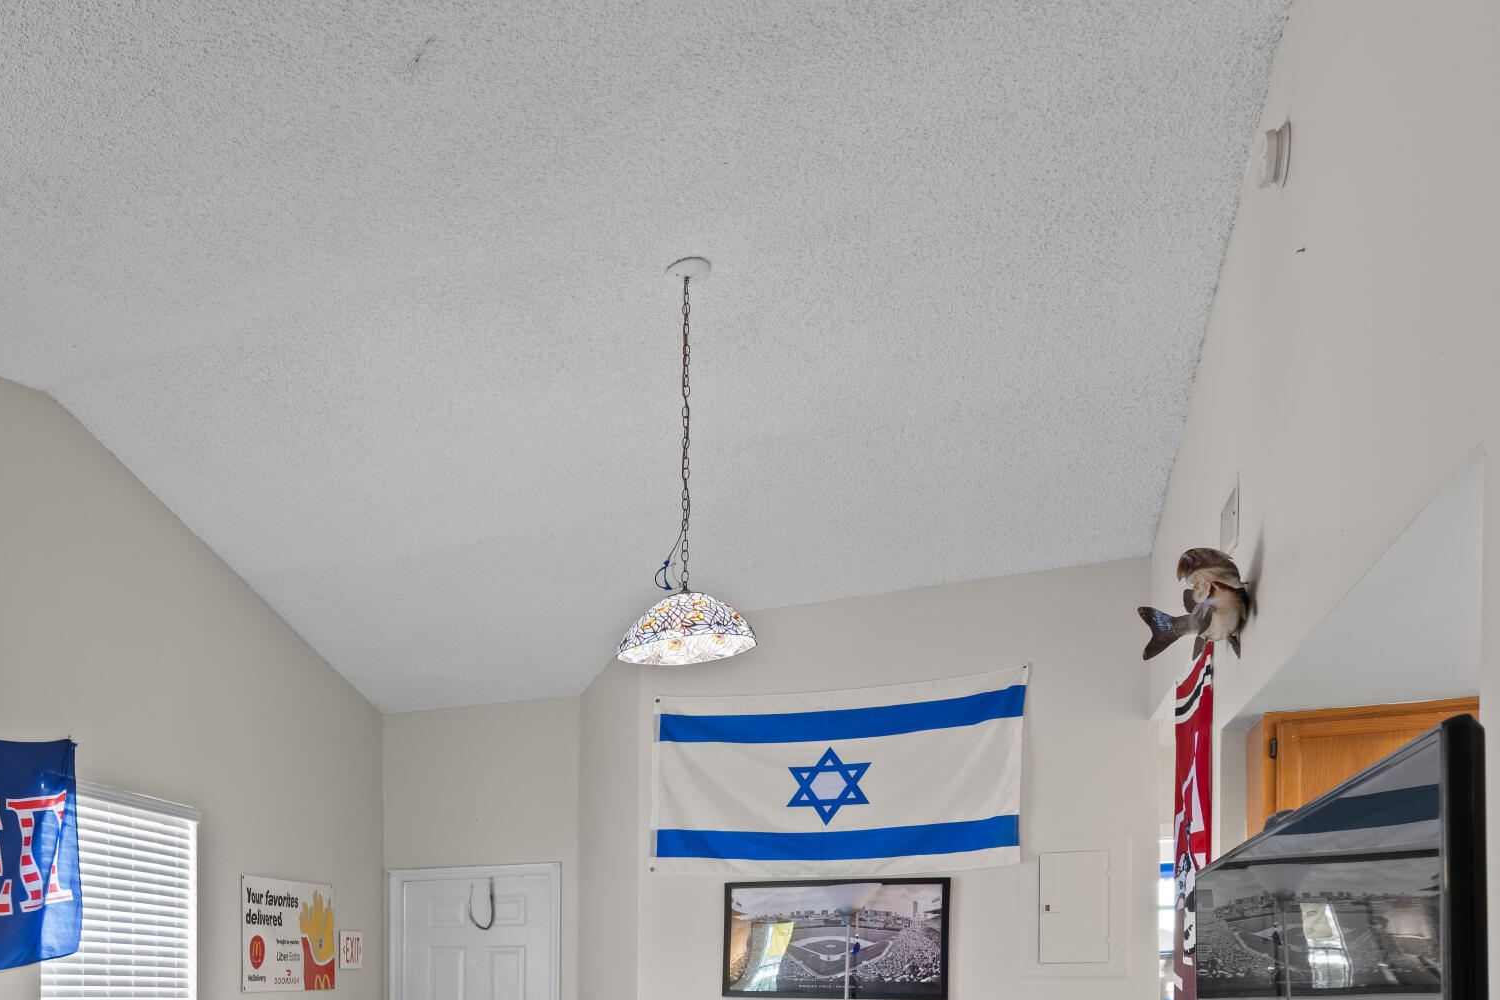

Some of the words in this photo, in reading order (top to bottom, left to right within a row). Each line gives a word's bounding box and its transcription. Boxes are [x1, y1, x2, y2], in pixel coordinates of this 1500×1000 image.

[246, 887, 264, 905] Your
[265, 890, 299, 908] favorites
[246, 909, 283, 926] delivered
[276, 951, 289, 962] Uber
[289, 952, 300, 962] Eats
[345, 937, 360, 964] EXIT
